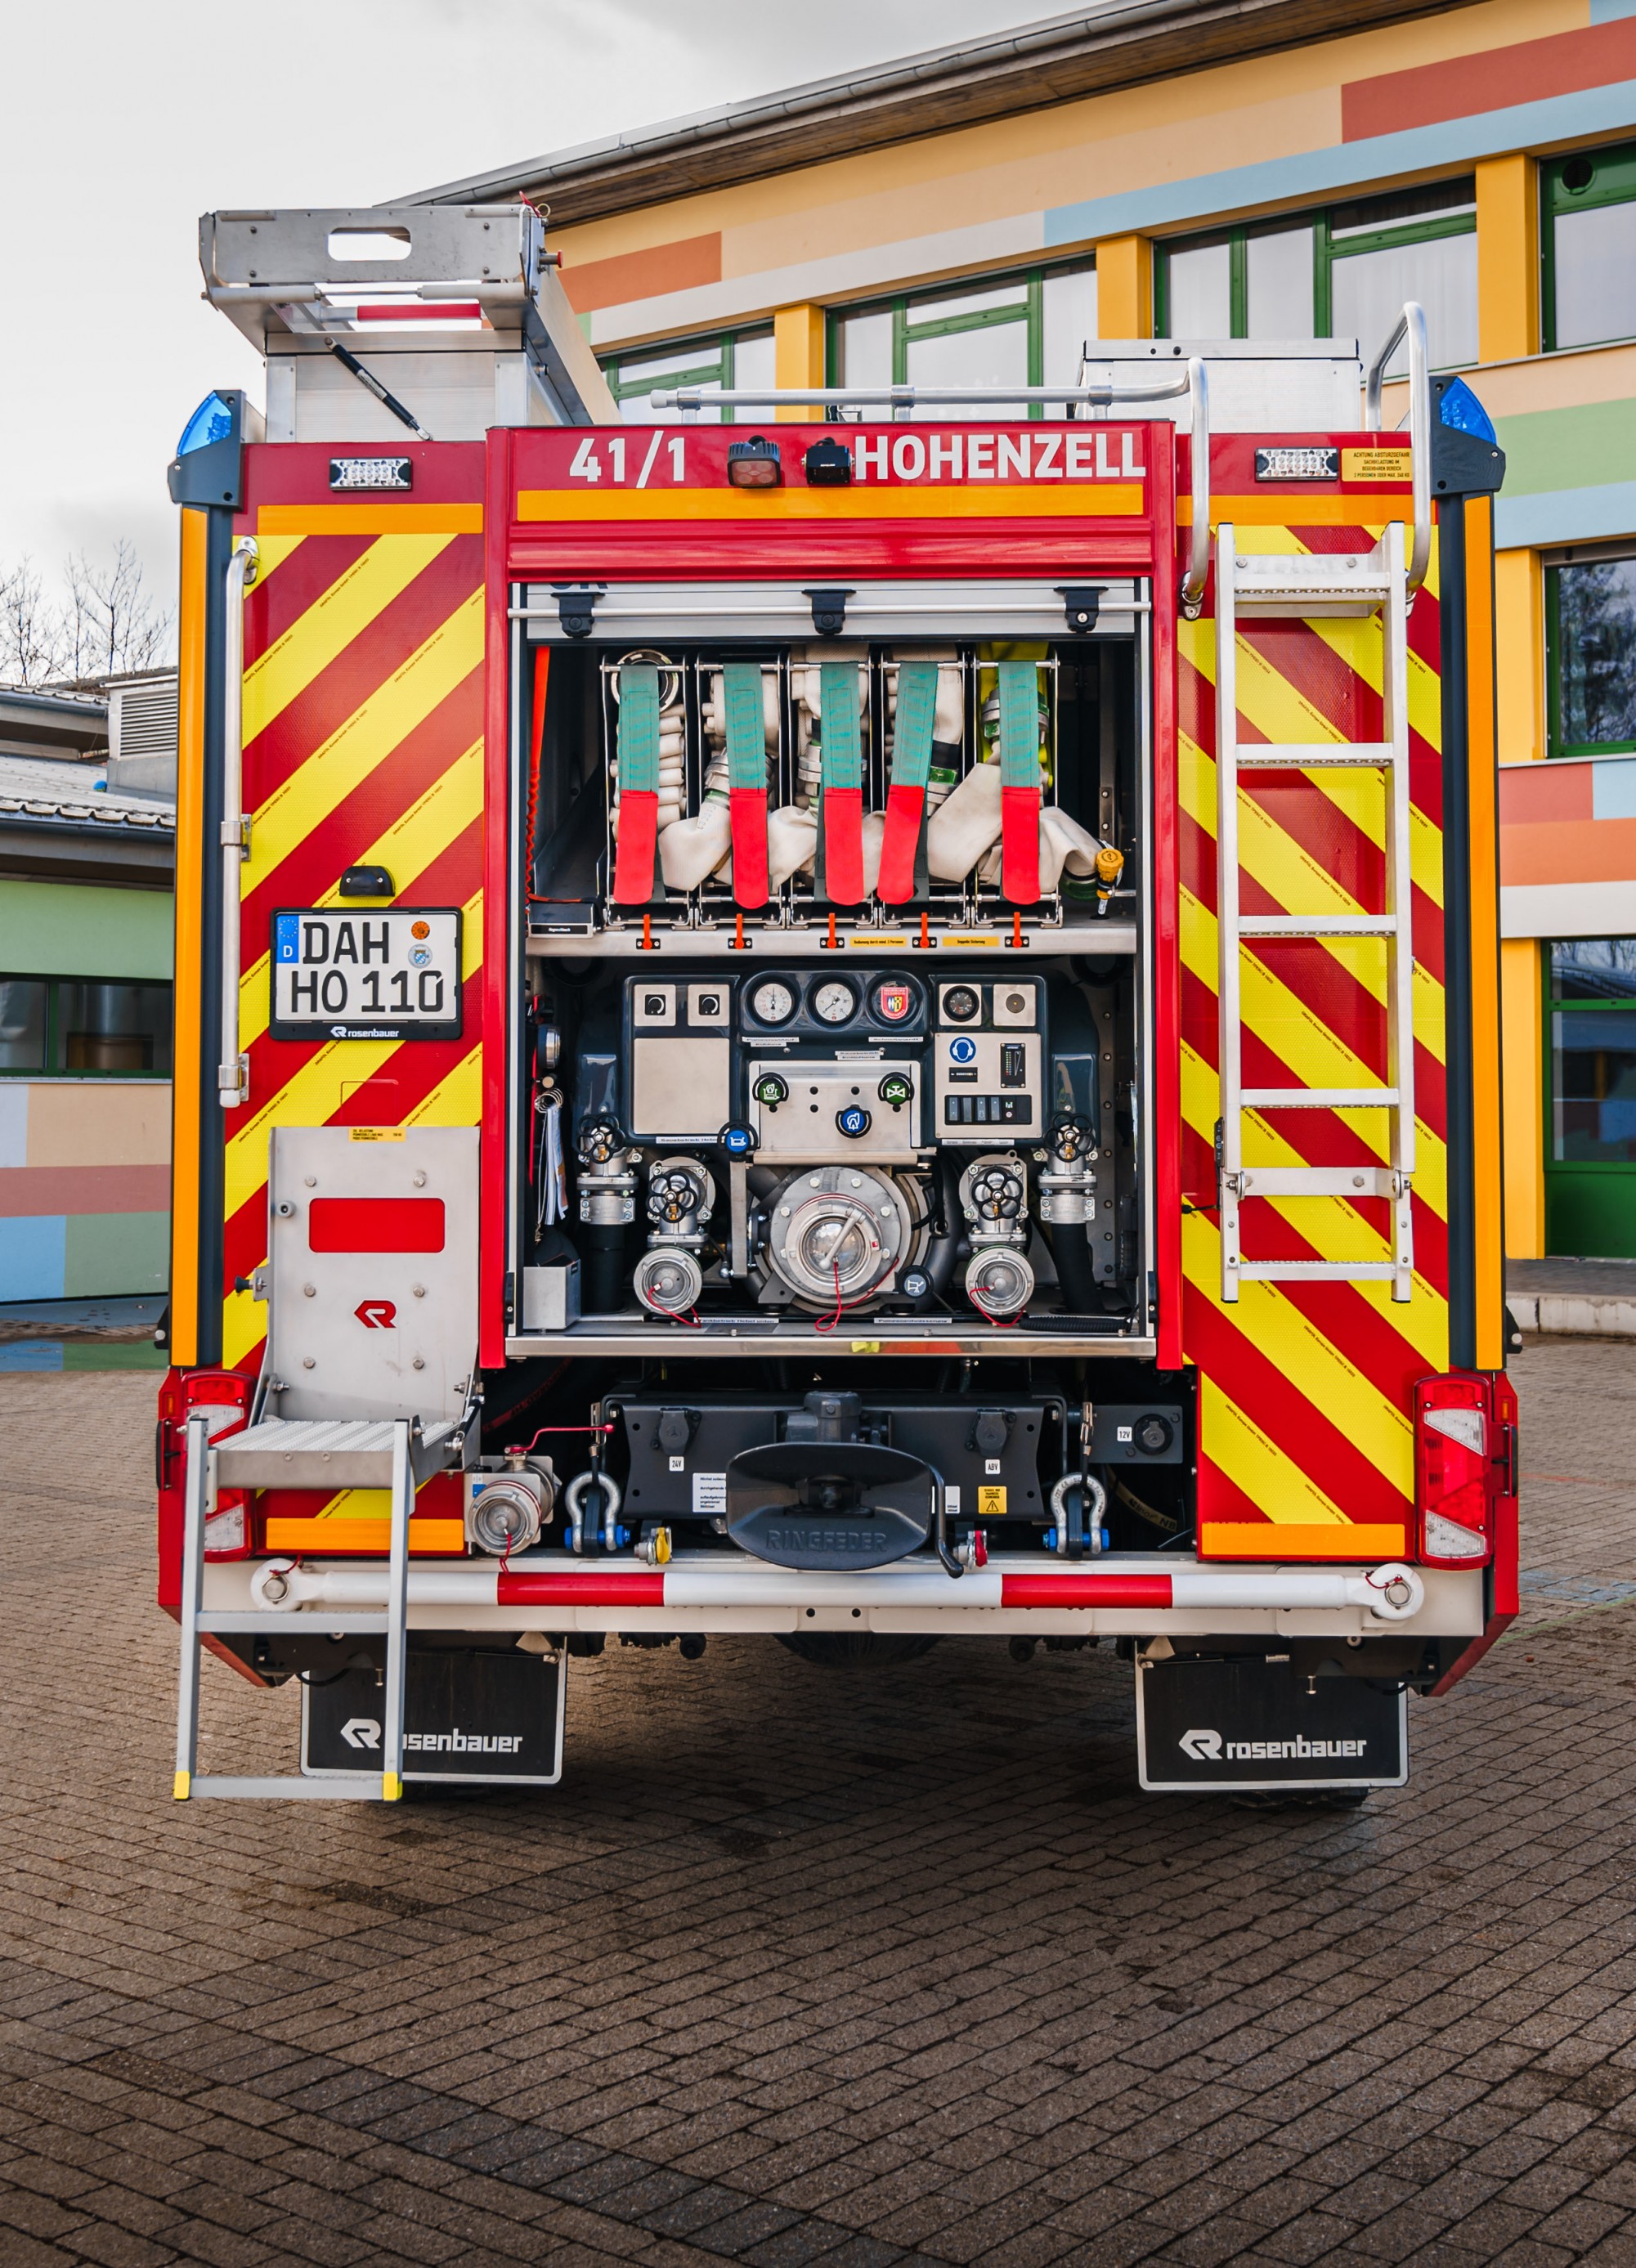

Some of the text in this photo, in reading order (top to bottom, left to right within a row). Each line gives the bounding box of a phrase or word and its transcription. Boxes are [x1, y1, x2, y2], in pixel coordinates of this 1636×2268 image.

[569, 431, 686, 488] 41/1
[856, 433, 1146, 480] HOHENZELL
[283, 922, 389, 964] D DAH
[292, 970, 444, 1013] HO 110
[348, 1026, 399, 1038] rosenbauer
[766, 1530, 887, 1552] RINGFEDER
[402, 1728, 522, 1753] senbauer
[1227, 1734, 1367, 1759] rosenbauer
